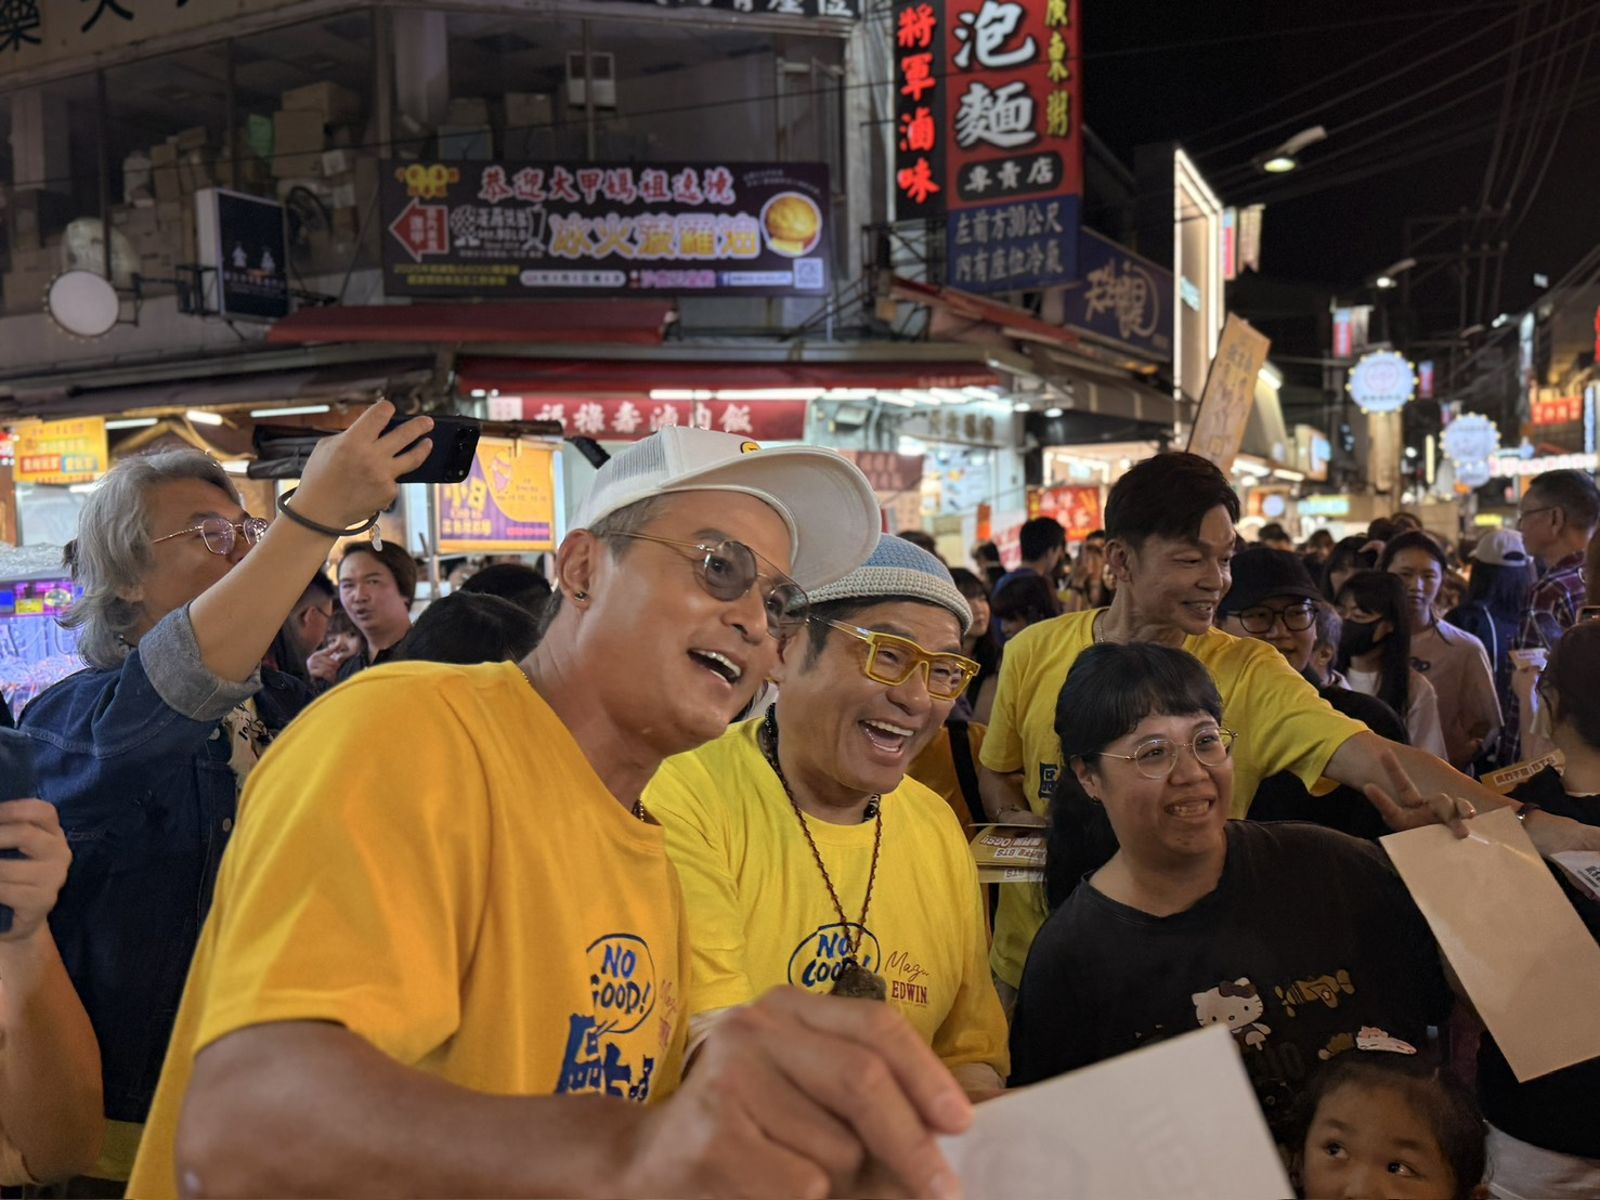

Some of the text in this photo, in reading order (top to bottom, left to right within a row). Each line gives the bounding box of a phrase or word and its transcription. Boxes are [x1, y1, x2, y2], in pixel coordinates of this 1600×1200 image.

[954, 0, 1036, 148] 泡麵
[897, 3, 940, 204] 將軍滷味
[964, 157, 1055, 193] 專賣店
[601, 944, 637, 978] NO
[817, 932, 850, 959] NO
[891, 980, 928, 1005] EDWIN
